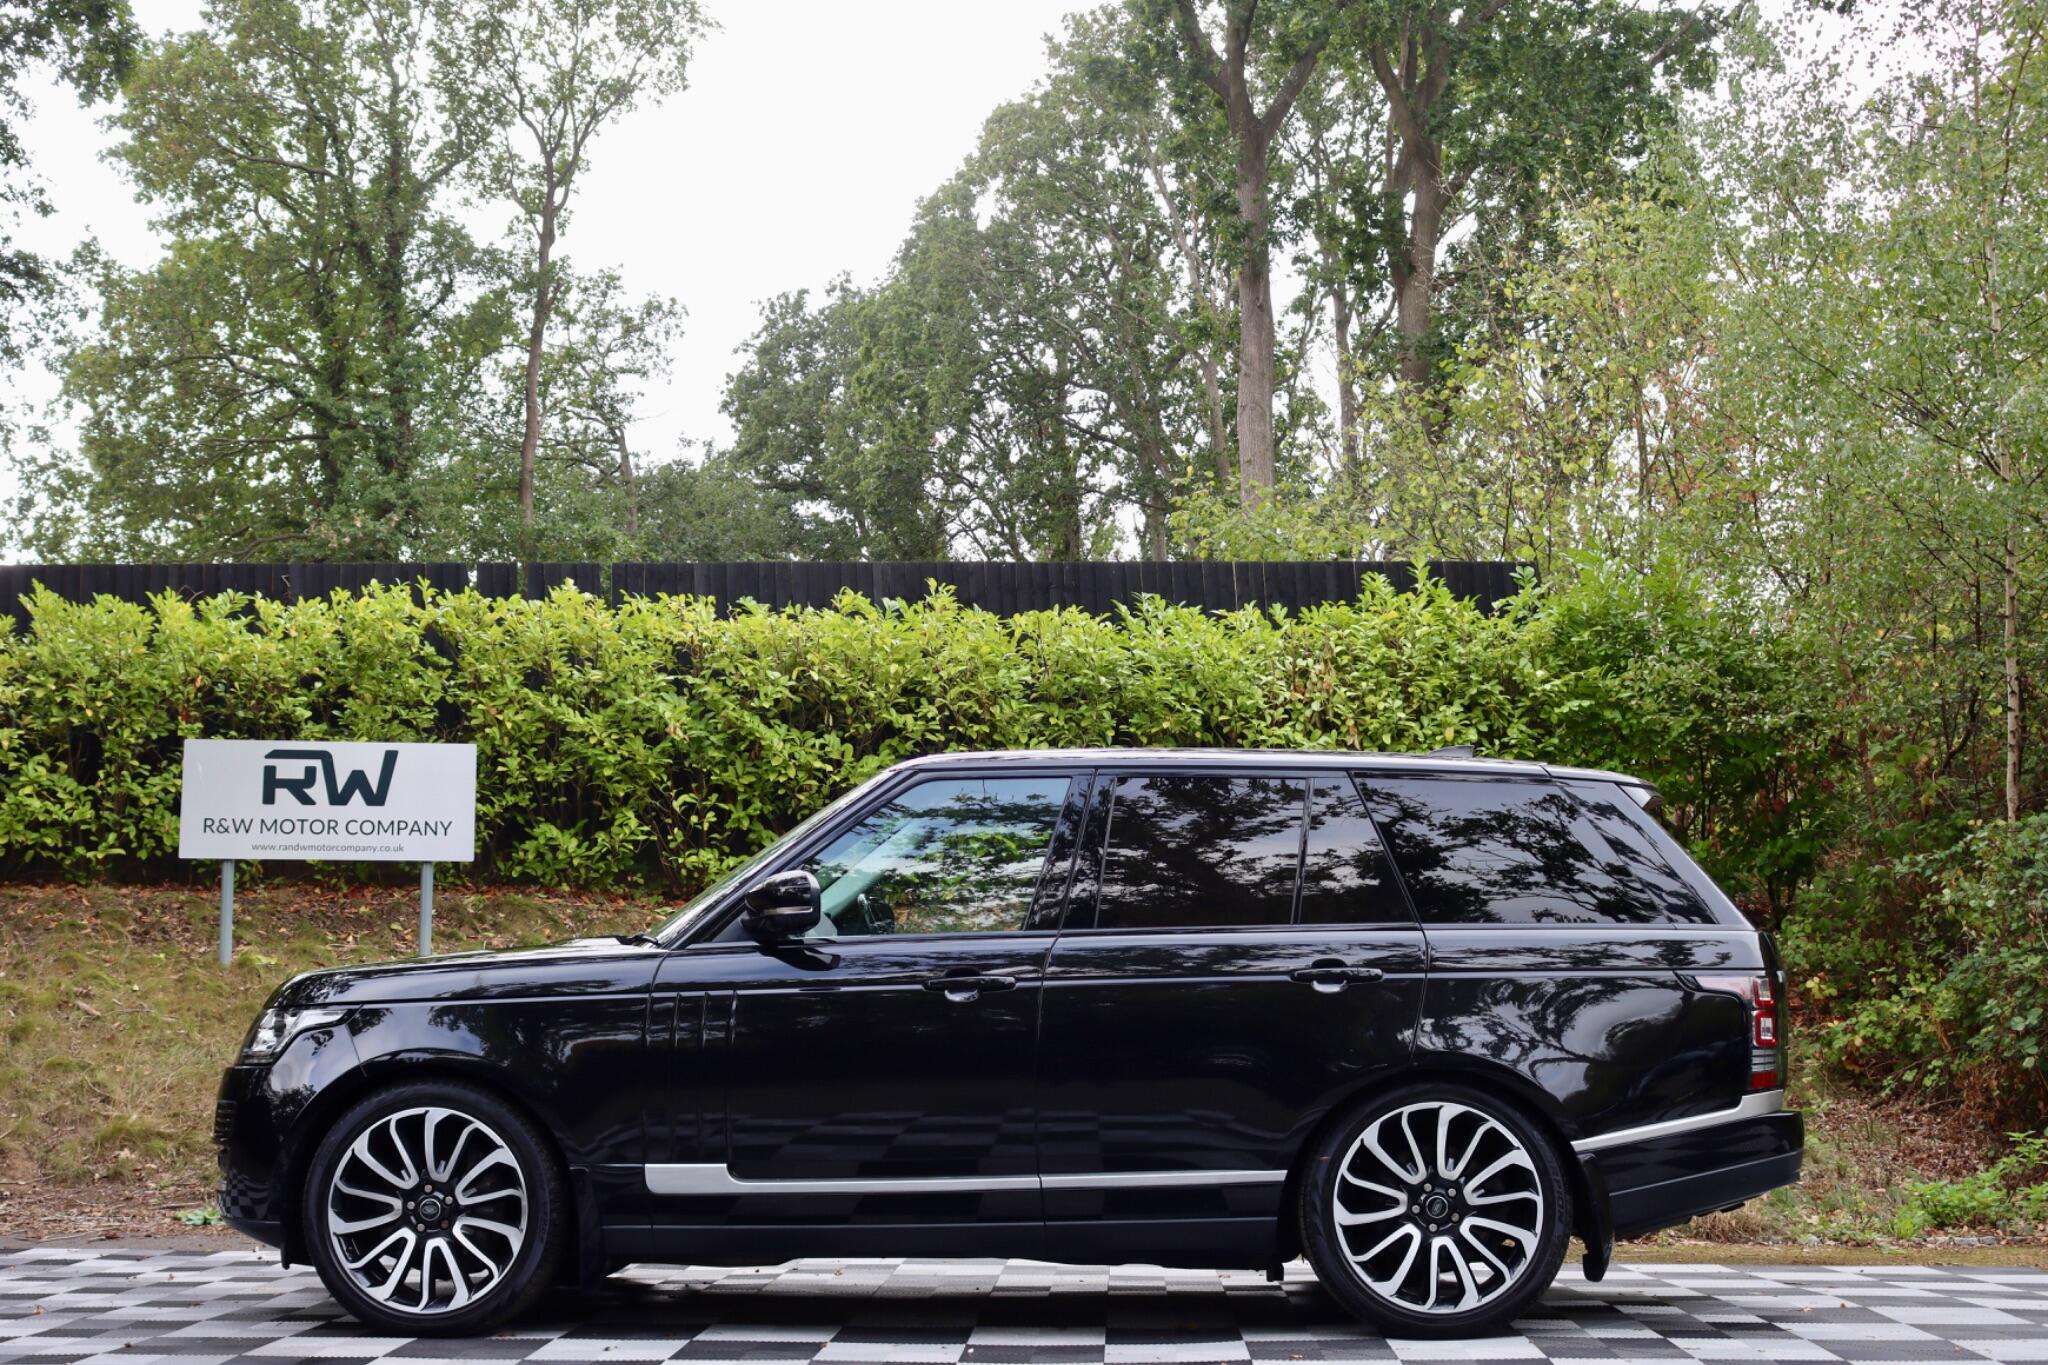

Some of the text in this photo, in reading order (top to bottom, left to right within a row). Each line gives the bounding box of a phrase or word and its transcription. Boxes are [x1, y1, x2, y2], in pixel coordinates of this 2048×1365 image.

[262, 749, 399, 806] RW
[203, 818, 453, 837] R&W MOTOR COMPANY
[251, 842, 404, 853] www.randwmotorcompany.co.uk
